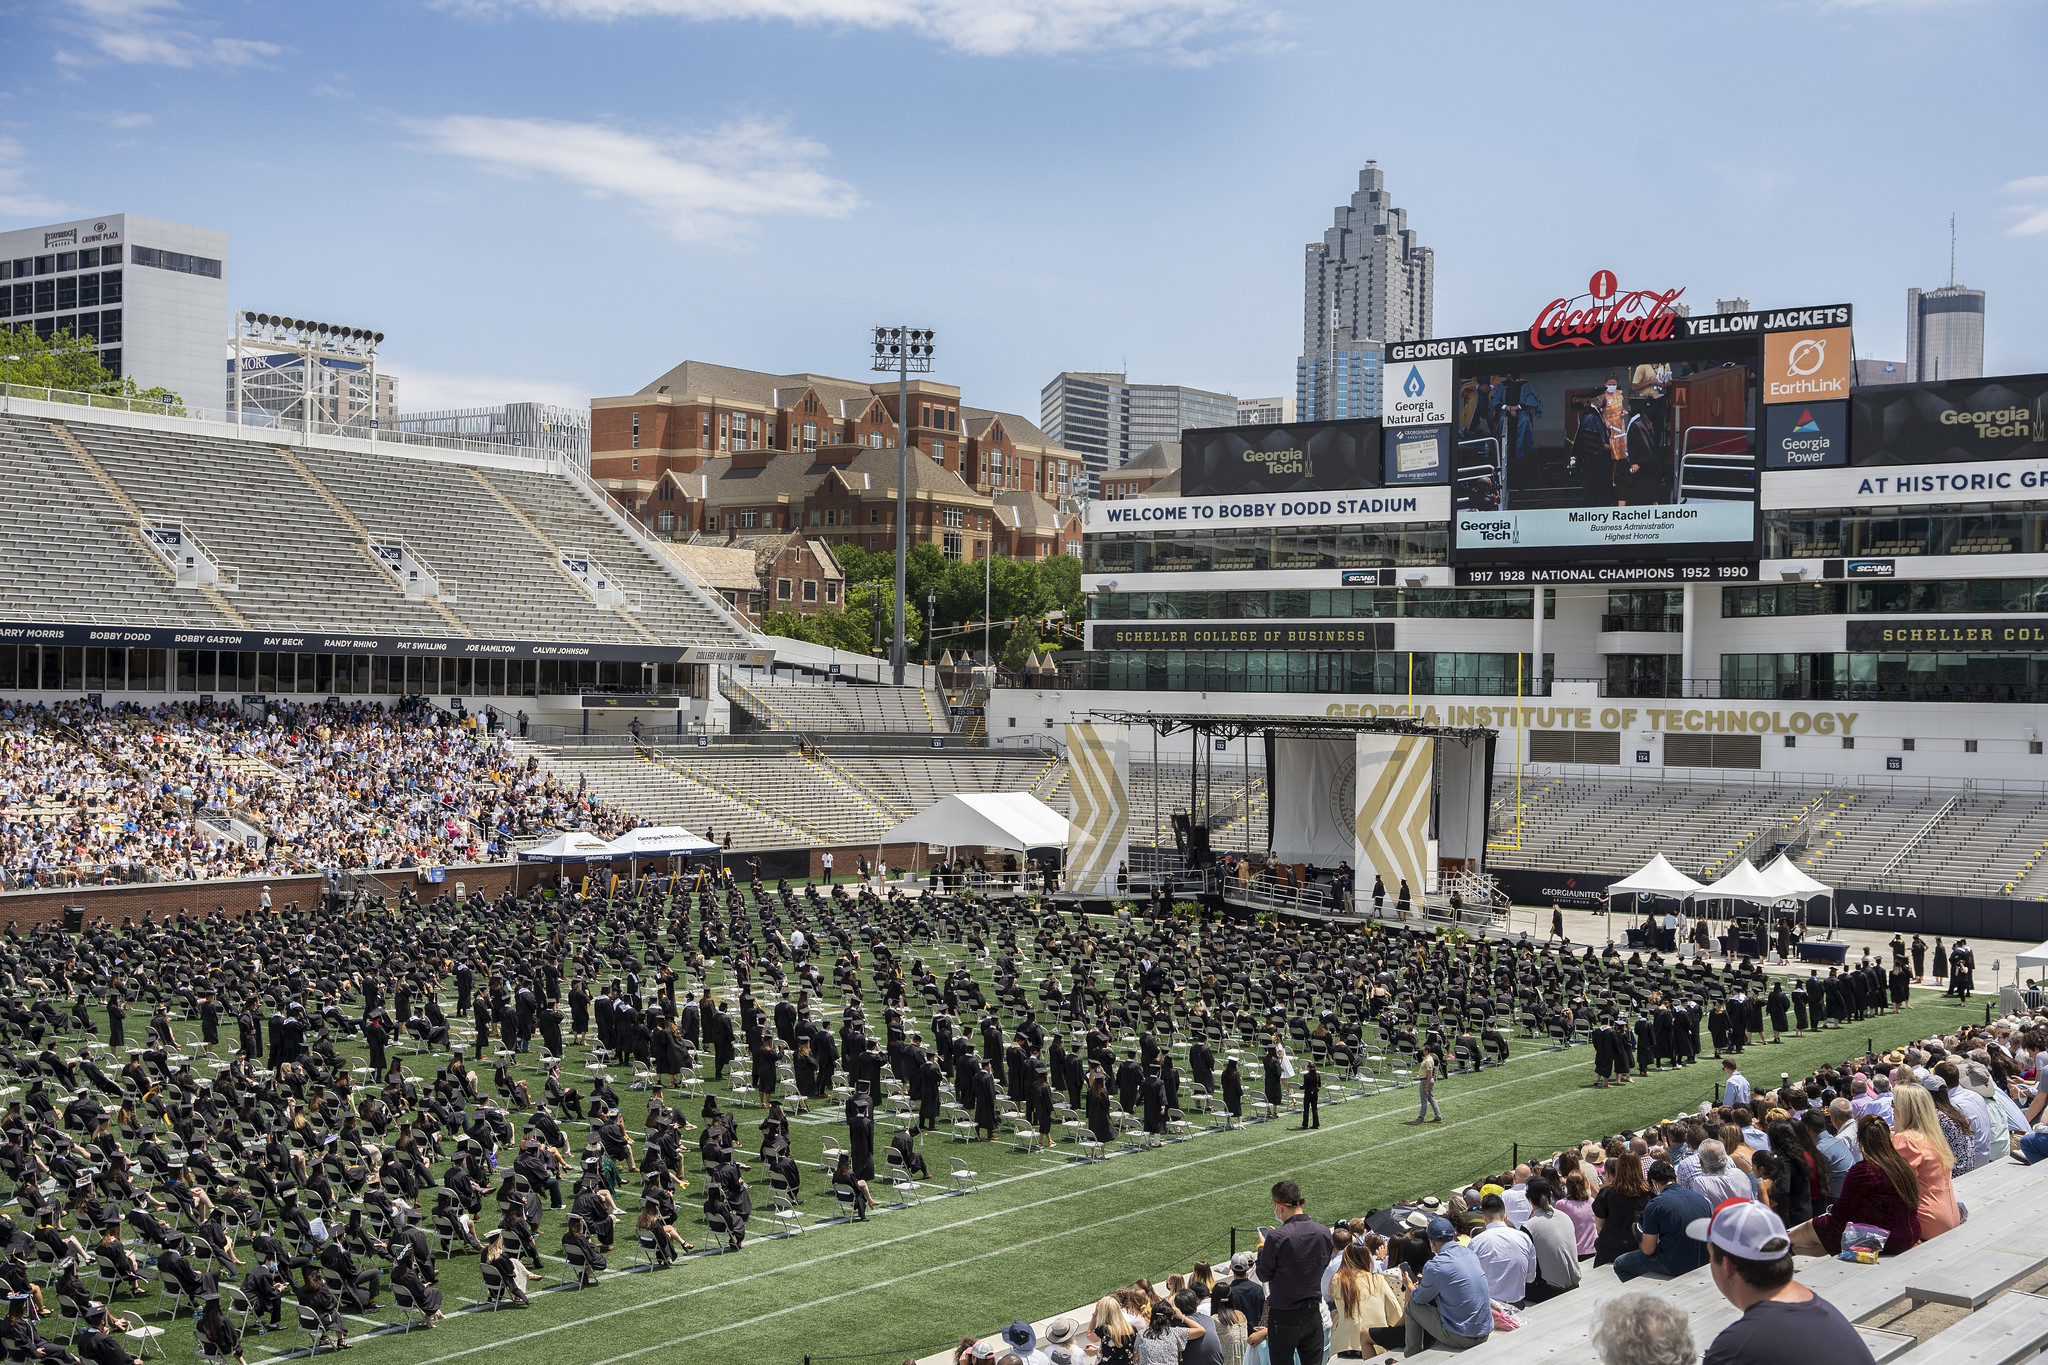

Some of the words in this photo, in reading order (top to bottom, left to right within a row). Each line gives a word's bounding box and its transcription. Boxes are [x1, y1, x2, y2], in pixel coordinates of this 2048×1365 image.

[48, 230, 74, 240] STAYBRIDGE
[82, 234, 102, 243] CROWNE
[103, 232, 118, 240] PLAZA
[1926, 290, 1958, 299] WESTIN
[1530, 286, 1686, 349] Coca-Cola
[1687, 315, 1759, 334] YELLOW
[1764, 308, 1848, 329] JACKETS
[1392, 340, 1468, 360] GEORGIA
[1472, 336, 1518, 353] TECH
[1770, 378, 1842, 396] EarthLink
[1395, 400, 1434, 412] Georgia
[1387, 413, 1424, 425] Natural
[1427, 412, 1444, 422] Gas
[1940, 406, 2029, 424] Georgia
[1974, 422, 2029, 438] Tech
[1782, 436, 1830, 450] Georgia
[1242, 448, 1303, 463] Georgia
[1787, 451, 1825, 462] Power
[1266, 461, 1303, 474] Tech
[1858, 478, 1888, 494] AT
[1897, 472, 2011, 492] HISTORIC
[1106, 506, 1186, 522] WELCOME
[1192, 506, 1214, 519] TO
[1219, 503, 1276, 518] BOBBY
[1281, 500, 1332, 516] DODD
[1337, 498, 1416, 514] STADIUM
[1568, 512, 1609, 523] Mallory
[1612, 510, 1650, 520] Rachel
[1654, 508, 1698, 519] Landon
[1460, 520, 1511, 531] Georgia
[1624, 522, 1674, 530] Administration
[1480, 530, 1511, 540] Tech
[1605, 533, 1632, 542] Highest
[1634, 532, 1660, 540] Honors
[1470, 572, 1493, 582] 1917
[1500, 571, 1525, 581] 1928
[1532, 569, 1595, 580] NATIONAL
[1599, 568, 1675, 580] CHAMPIONS
[1681, 567, 1710, 578] 1952
[1718, 566, 1748, 577] 1990
[26, 629, 64, 638] MORRIS
[90, 632, 122, 640] BOBBY
[124, 633, 151, 641] DODD
[175, 634, 206, 643] BOBBY
[207, 636, 242, 644] GASTON
[1116, 632, 1187, 642] SCHELLER
[1194, 632, 1257, 642] COLLEGE
[1264, 631, 1281, 642] OF
[1288, 631, 1365, 642] BUSINESS
[1883, 628, 1992, 641] SCHELLER
[2004, 628, 2044, 641] COL
[282, 638, 304, 646] BECK
[324, 640, 351, 648] RANDY
[480, 645, 516, 653] HAMILTON
[557, 647, 589, 655] JOHNSON
[696, 652, 716, 660] COLLEGE
[716, 652, 728, 660] HALL
[735, 653, 747, 661] FAME
[1326, 704, 1440, 726] GEORGIA
[1448, 706, 1591, 728] INSTITUTE
[1600, 708, 1637, 729] OF
[1646, 709, 1858, 734] TECHNOLOGY
[1542, 888, 1601, 899] GEORGIAUNITED
[1864, 904, 1917, 918] DELTA
